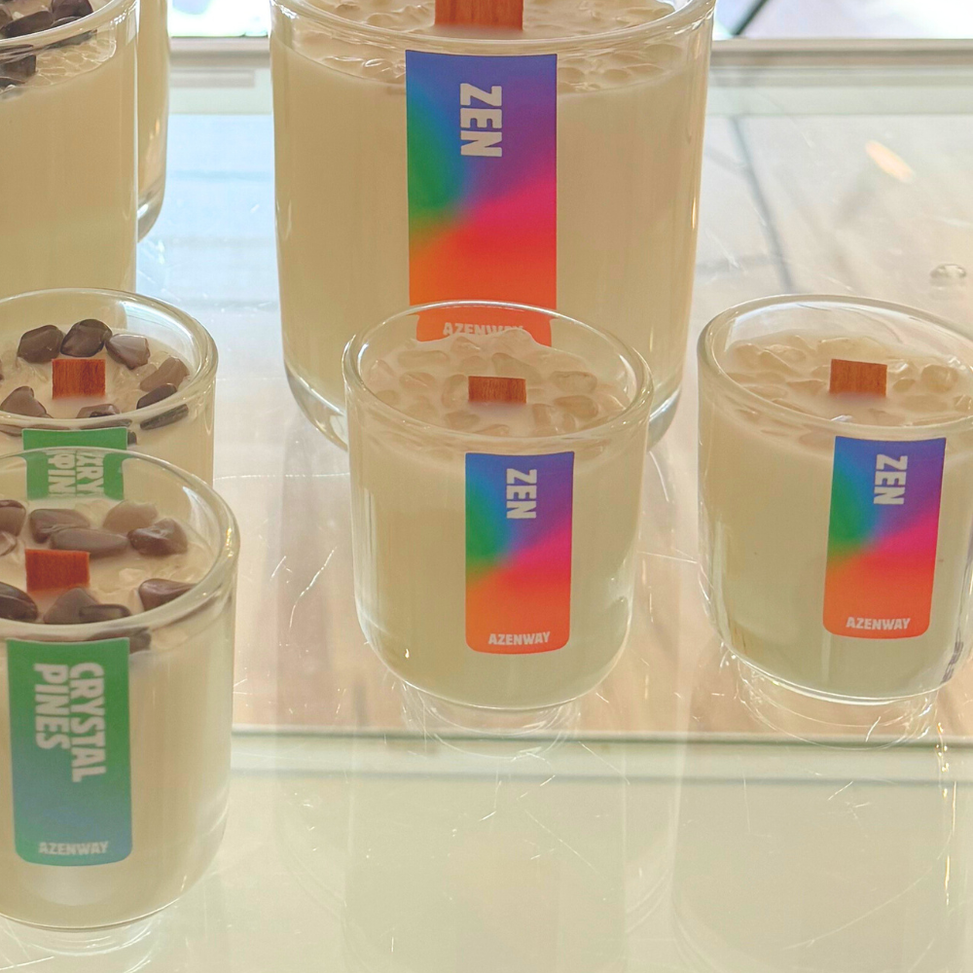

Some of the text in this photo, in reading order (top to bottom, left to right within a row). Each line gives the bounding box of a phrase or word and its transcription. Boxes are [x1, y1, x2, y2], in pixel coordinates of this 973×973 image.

[459, 82, 503, 158] ZEN
[506, 467, 538, 520] ZEN
[873, 453, 909, 505] ZEN
[487, 631, 551, 647] AZENWAY
[846, 616, 911, 631] AZENWAY
[33, 663, 70, 750] PINES
[68, 662, 107, 783] CRYSTAL
[38, 840, 110, 857] AZENWAY
